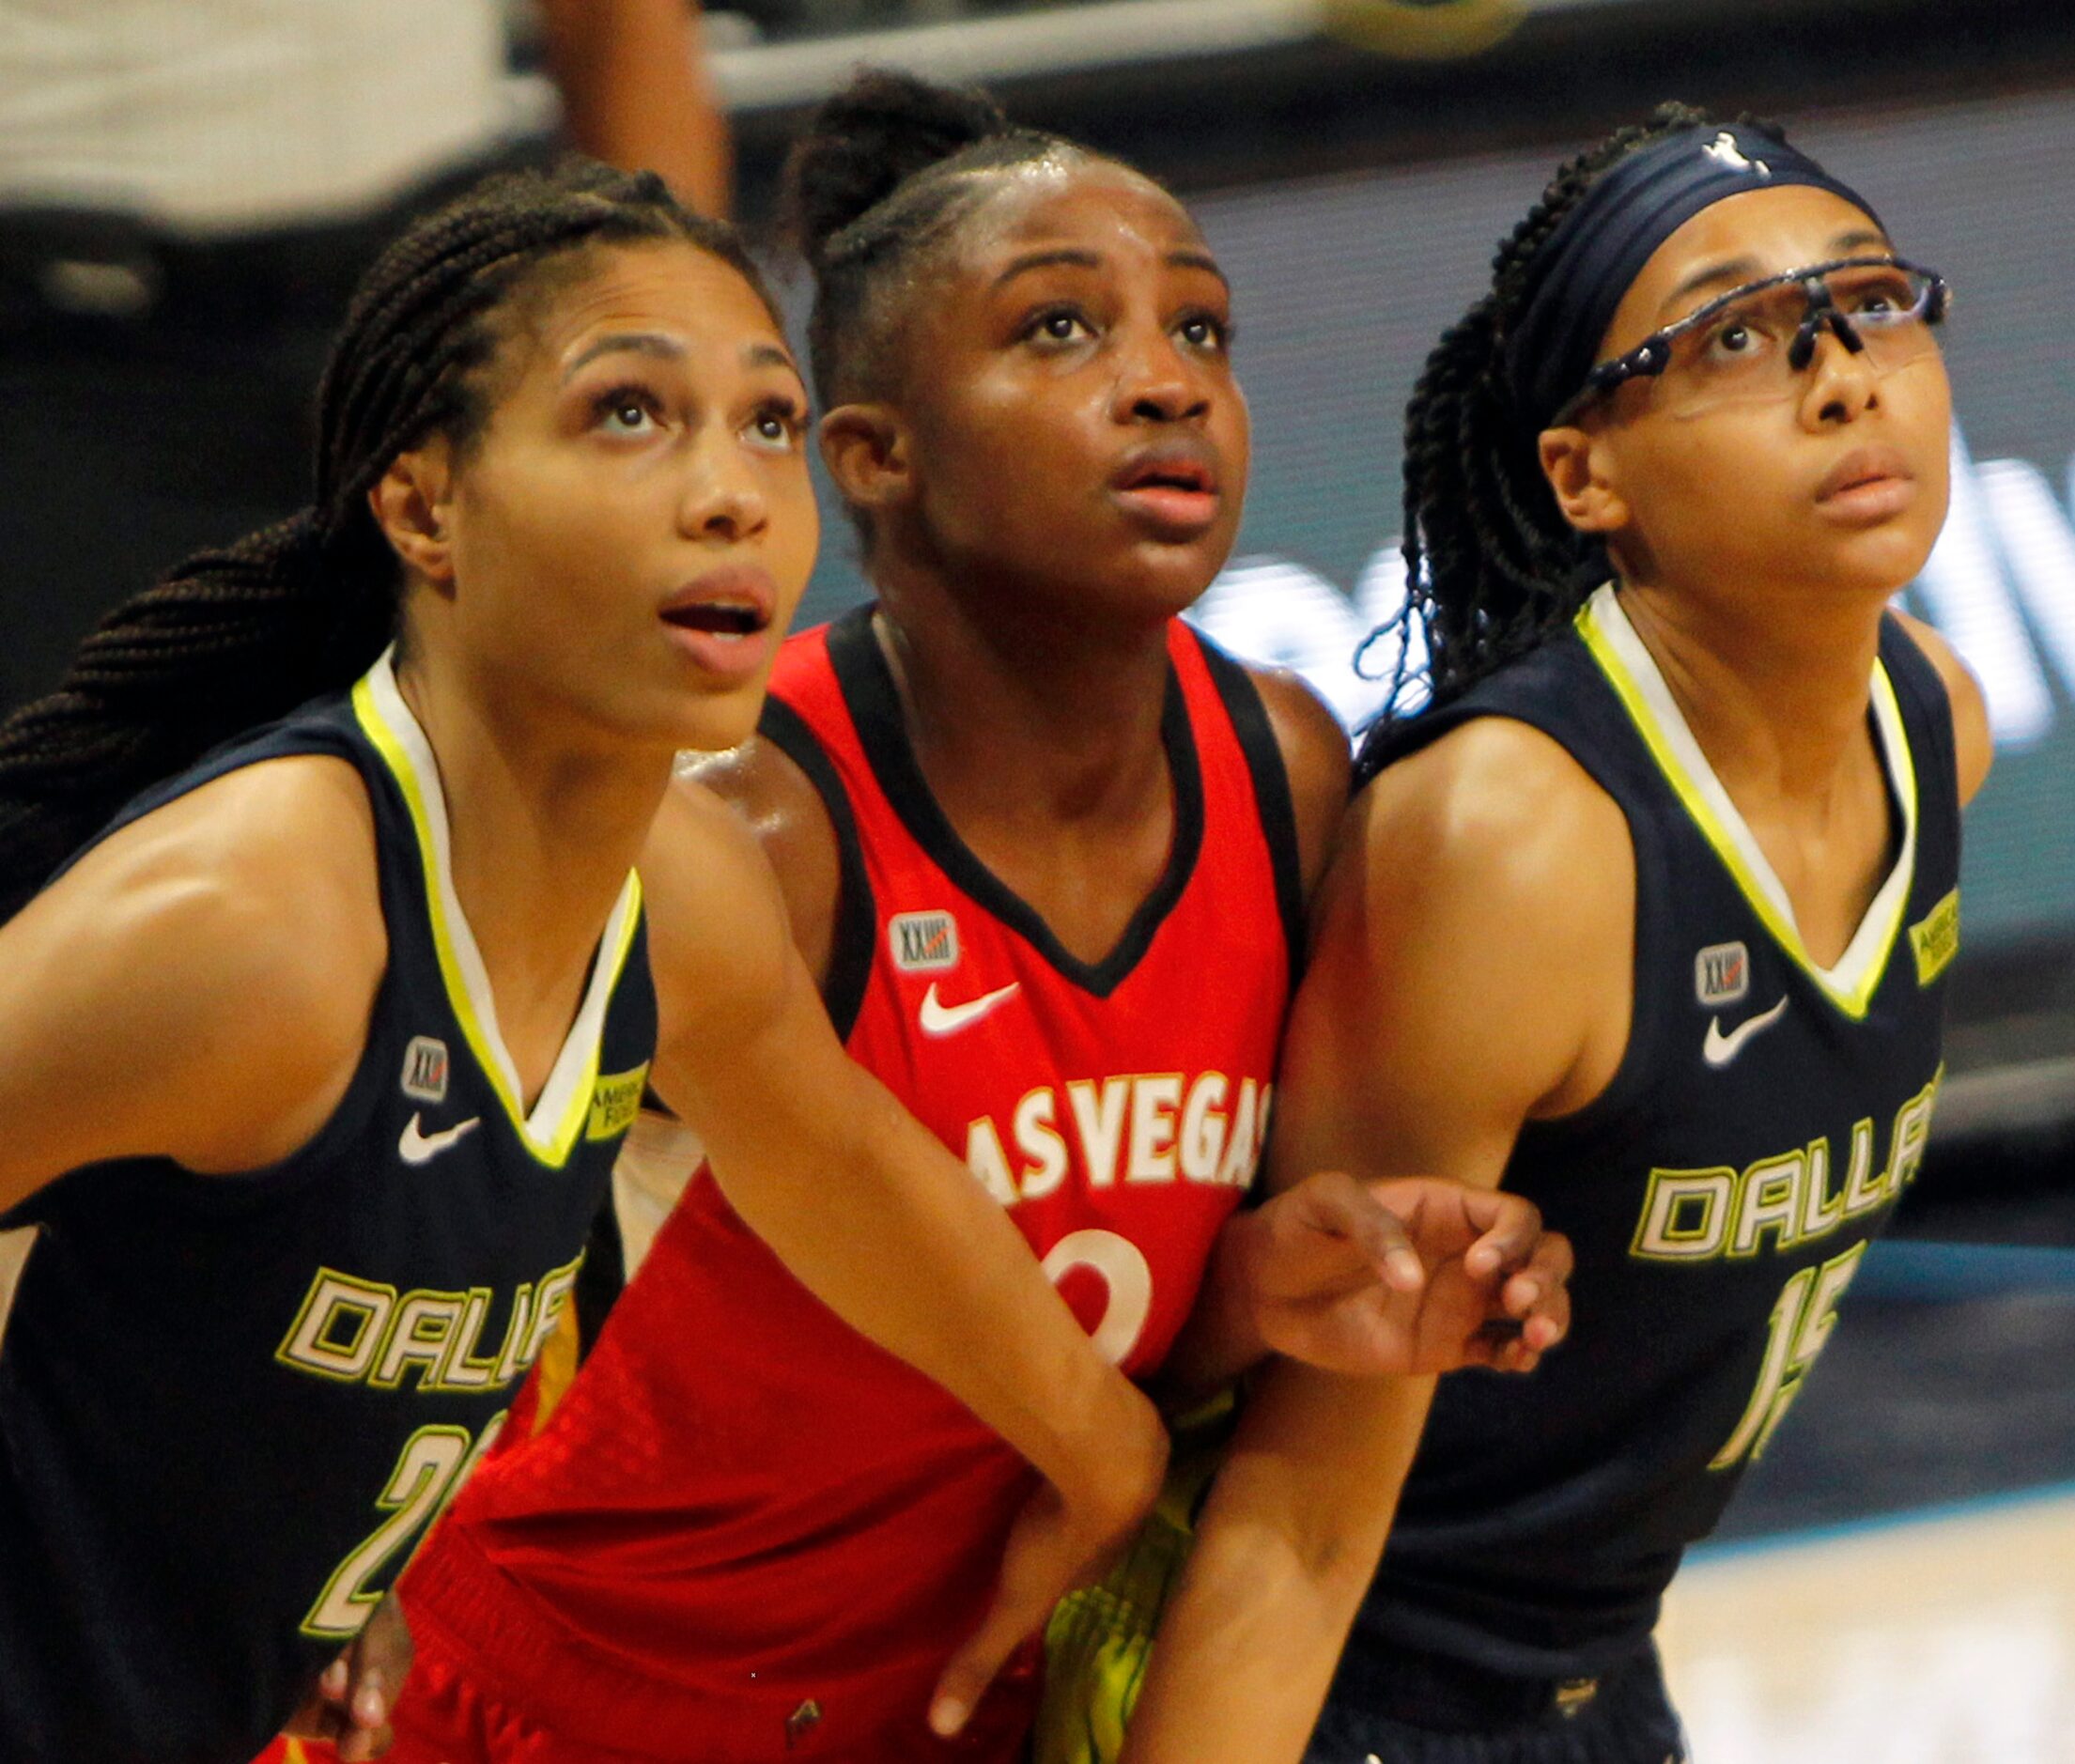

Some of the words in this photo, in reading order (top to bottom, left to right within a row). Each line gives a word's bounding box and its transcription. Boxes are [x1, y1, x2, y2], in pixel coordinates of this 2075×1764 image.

[967, 1086, 1068, 1206] AS
[1629, 1061, 1944, 1261] DALLA
[274, 1246, 587, 1392] DALLA
[300, 1409, 508, 1639] 2
